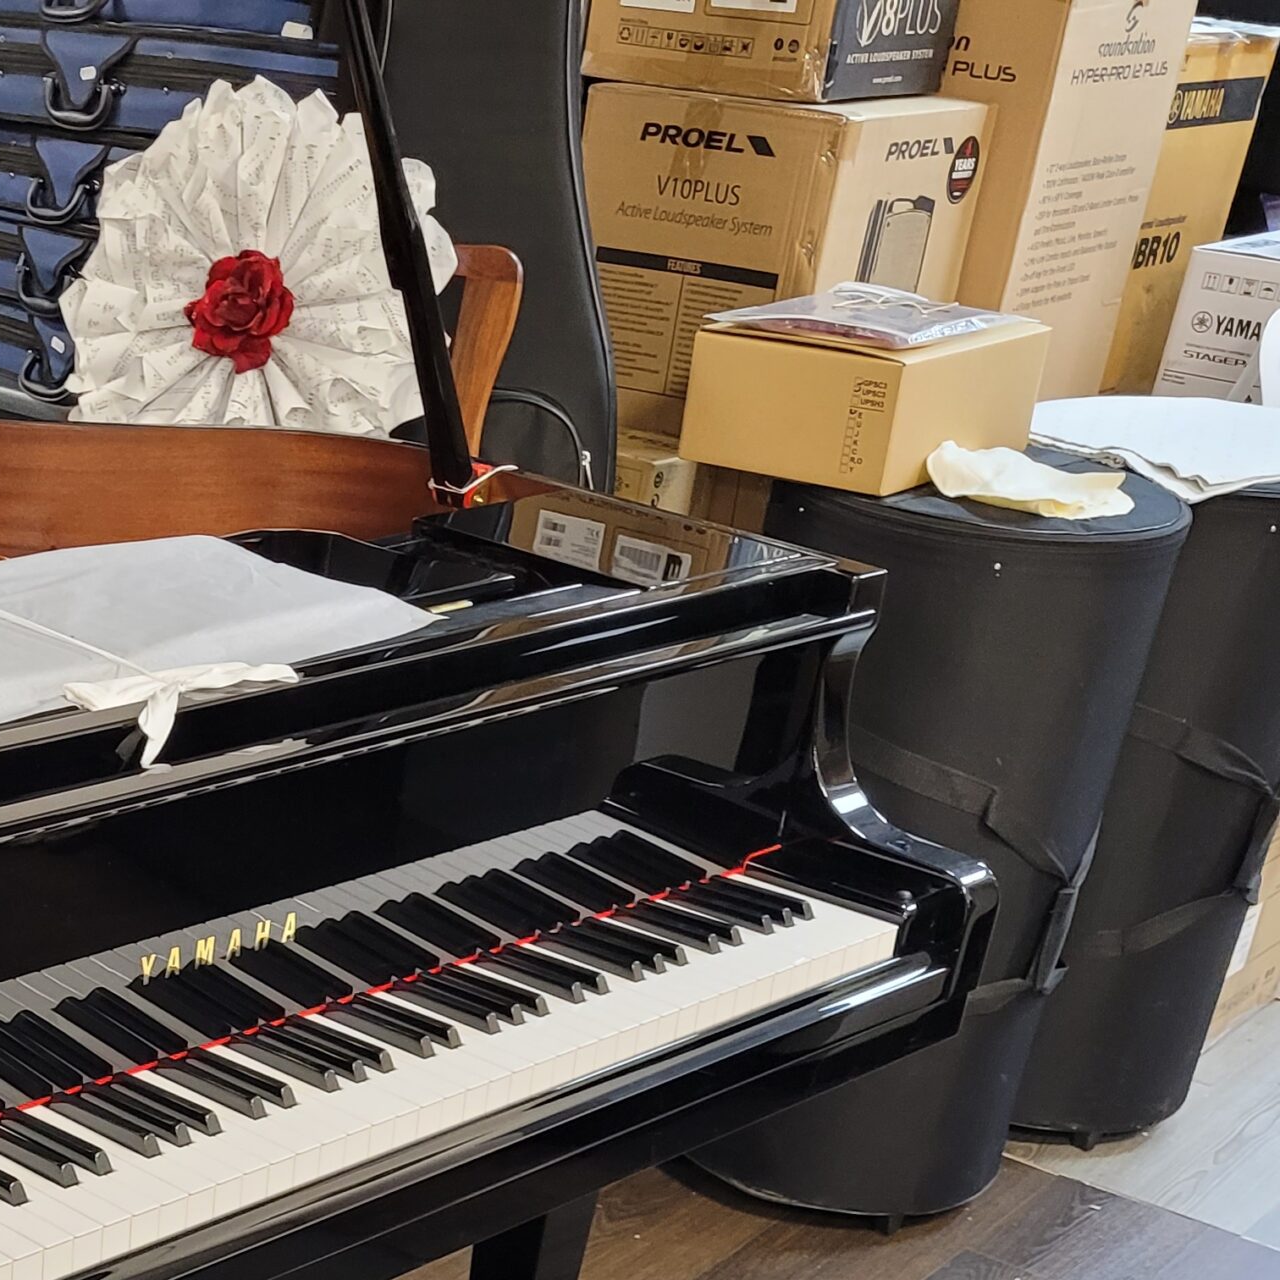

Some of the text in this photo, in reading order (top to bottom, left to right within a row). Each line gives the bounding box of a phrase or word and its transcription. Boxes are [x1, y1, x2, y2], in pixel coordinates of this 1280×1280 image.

[846, 49, 934, 64] ACTIVE LOUDSPEAKER SYSTEM
[952, 60, 1017, 82] PLUS
[1071, 64, 1131, 85] HYPER-PRO
[1143, 61, 1168, 77] PLUS
[1180, 87, 1225, 121] YAMAHA
[639, 122, 745, 153] PROEL
[885, 138, 940, 162] PROEL
[954, 158, 977, 171] YEARS
[657, 174, 742, 207] V10PLUS
[615, 200, 773, 237] Active Loudspeaker System
[1131, 231, 1181, 270] BR10
[667, 259, 703, 275] FEATURES
[1183, 350, 1247, 368] STAGEP
[140, 912, 297, 986] YAMAHA
